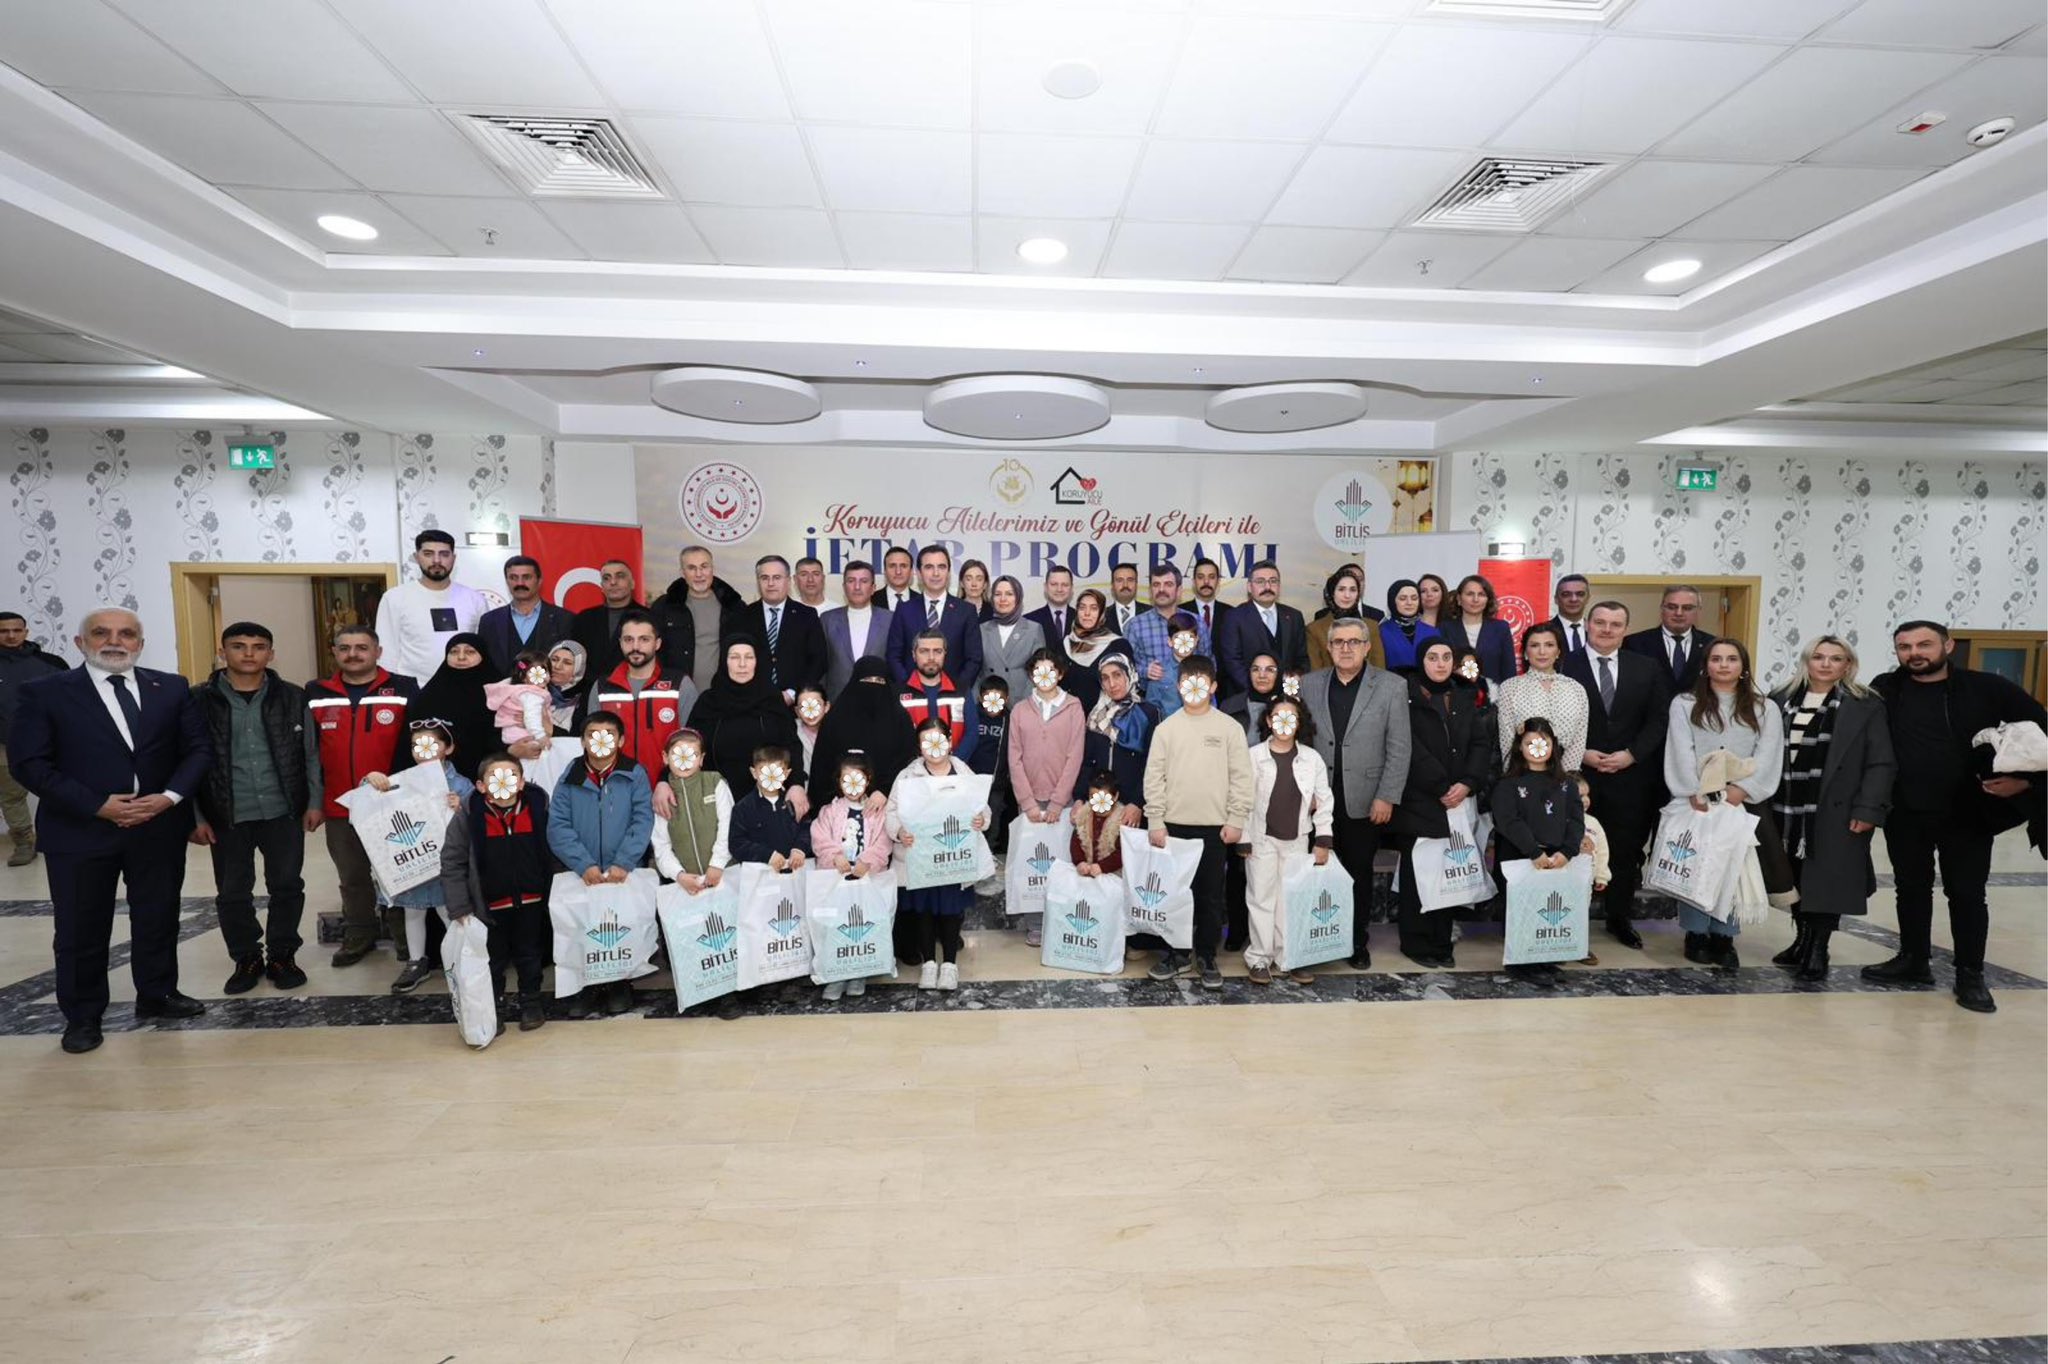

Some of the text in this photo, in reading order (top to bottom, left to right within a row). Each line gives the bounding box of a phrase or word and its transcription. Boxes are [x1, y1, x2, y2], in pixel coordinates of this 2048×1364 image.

[823, 504, 1261, 540] Koruyucu Ailelerimiz ve Gönül Elçileri ile
[1335, 523, 1370, 539] BİTLİS
[987, 540, 1280, 578] PROGRAMI
[978, 724, 1003, 737] ENZ
[394, 840, 438, 866] BİTLİS
[934, 848, 972, 864] BİTLİS
[1445, 863, 1479, 880] BİTLİS
[1131, 905, 1167, 922] BİTLİS
[1063, 932, 1098, 949] BİTLİS
[1536, 925, 1572, 939] BİTLİS
[767, 935, 803, 954] BİTLİS
[837, 942, 876, 958] BİTLİS
[587, 947, 632, 965] BİTLİS
